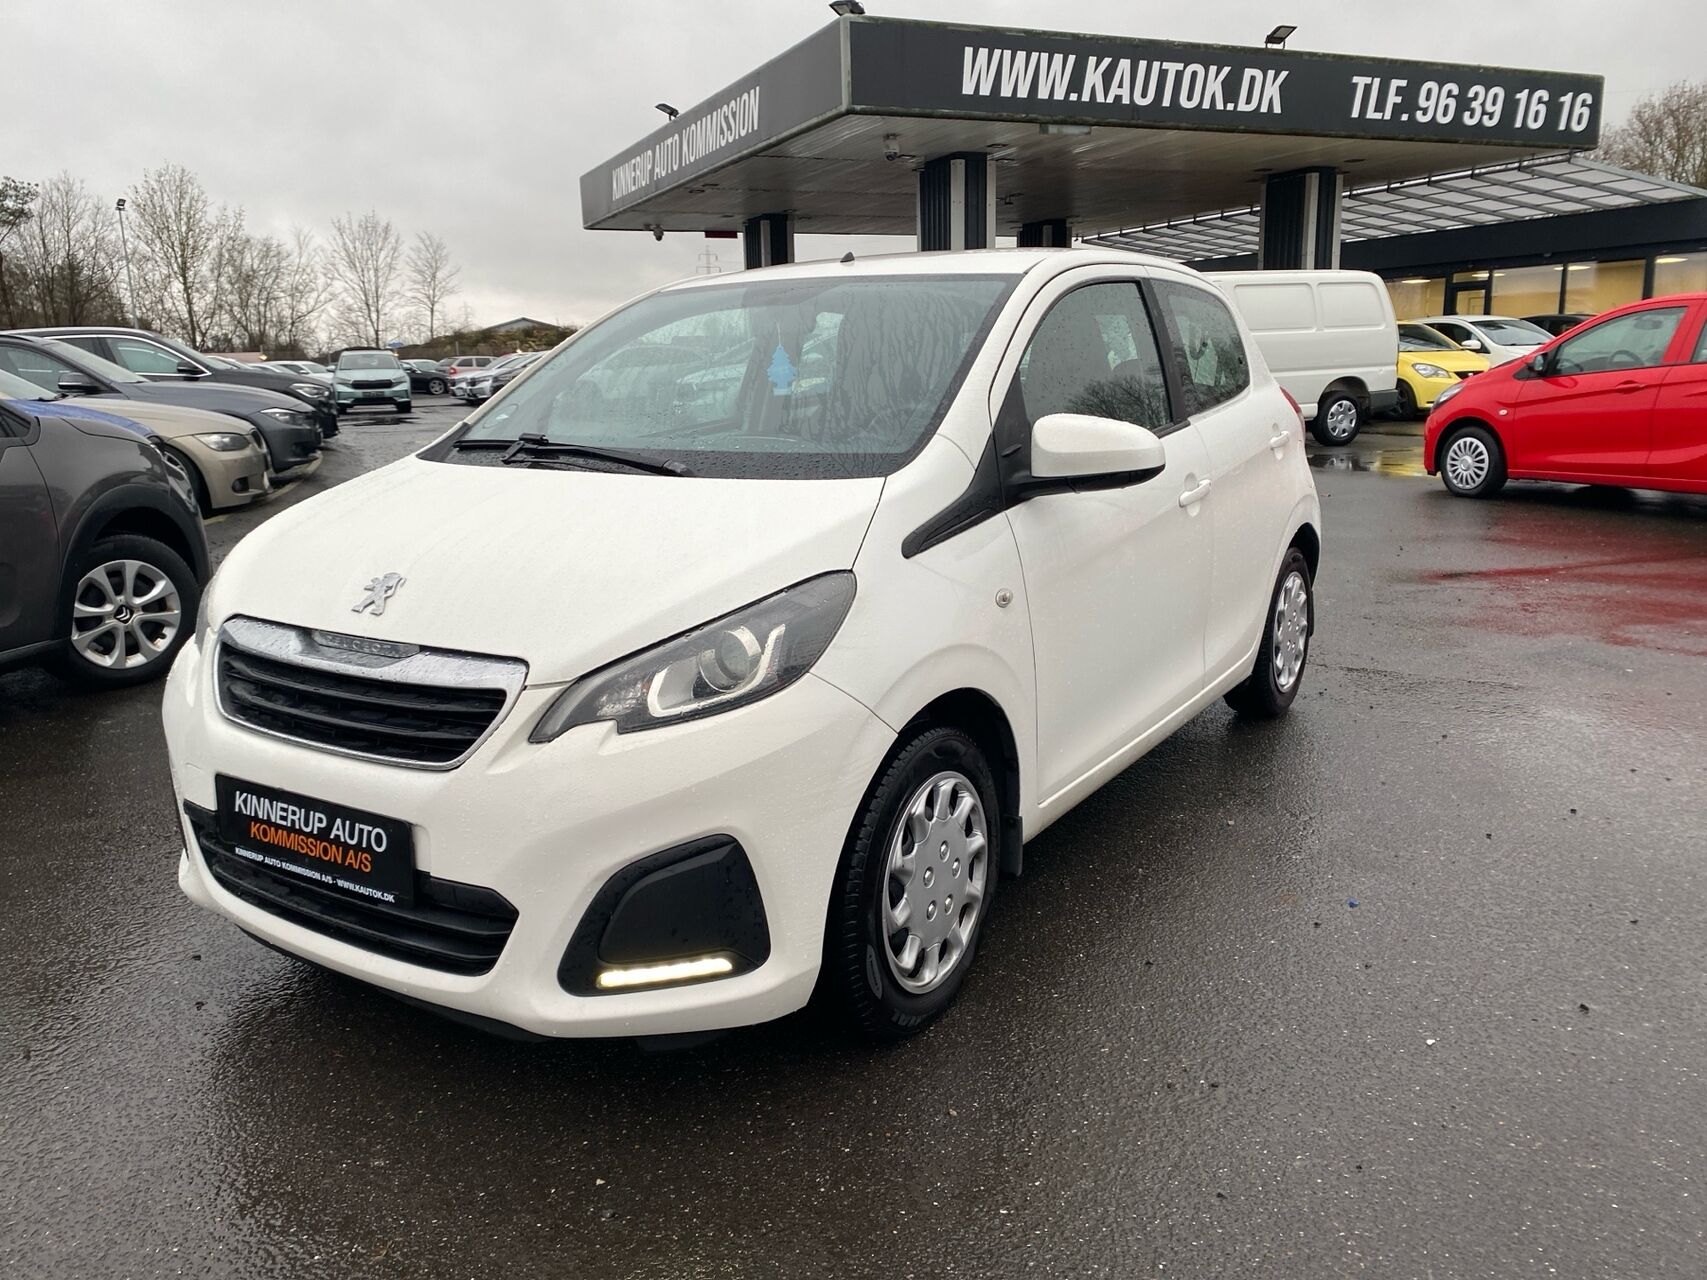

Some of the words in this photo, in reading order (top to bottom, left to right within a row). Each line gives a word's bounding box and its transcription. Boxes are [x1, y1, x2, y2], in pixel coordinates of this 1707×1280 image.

[962, 46, 1290, 114] WWW.KAUTOK.DK
[1351, 76, 1409, 121] TLF.
[1415, 81, 1459, 124] 96
[1463, 85, 1505, 127] 39
[1514, 89, 1550, 130] 16
[1557, 92, 1593, 132] 16
[612, 150, 652, 201] KINNERUP
[654, 133, 680, 181] AUTO
[682, 86, 760, 167] KOMMISSION
[234, 790, 327, 835] KINNERUP
[330, 818, 387, 853] AUTO
[250, 821, 342, 864] KOMMISSION
[345, 849, 372, 873] A/S
[235, 847, 264, 862] KINNERUP
[264, 855, 281, 868] AUTO
[281, 861, 321, 881] KOMMISSION
[321, 873, 333, 884] A/S
[337, 879, 395, 903] WWW.KAUTOK.DK
